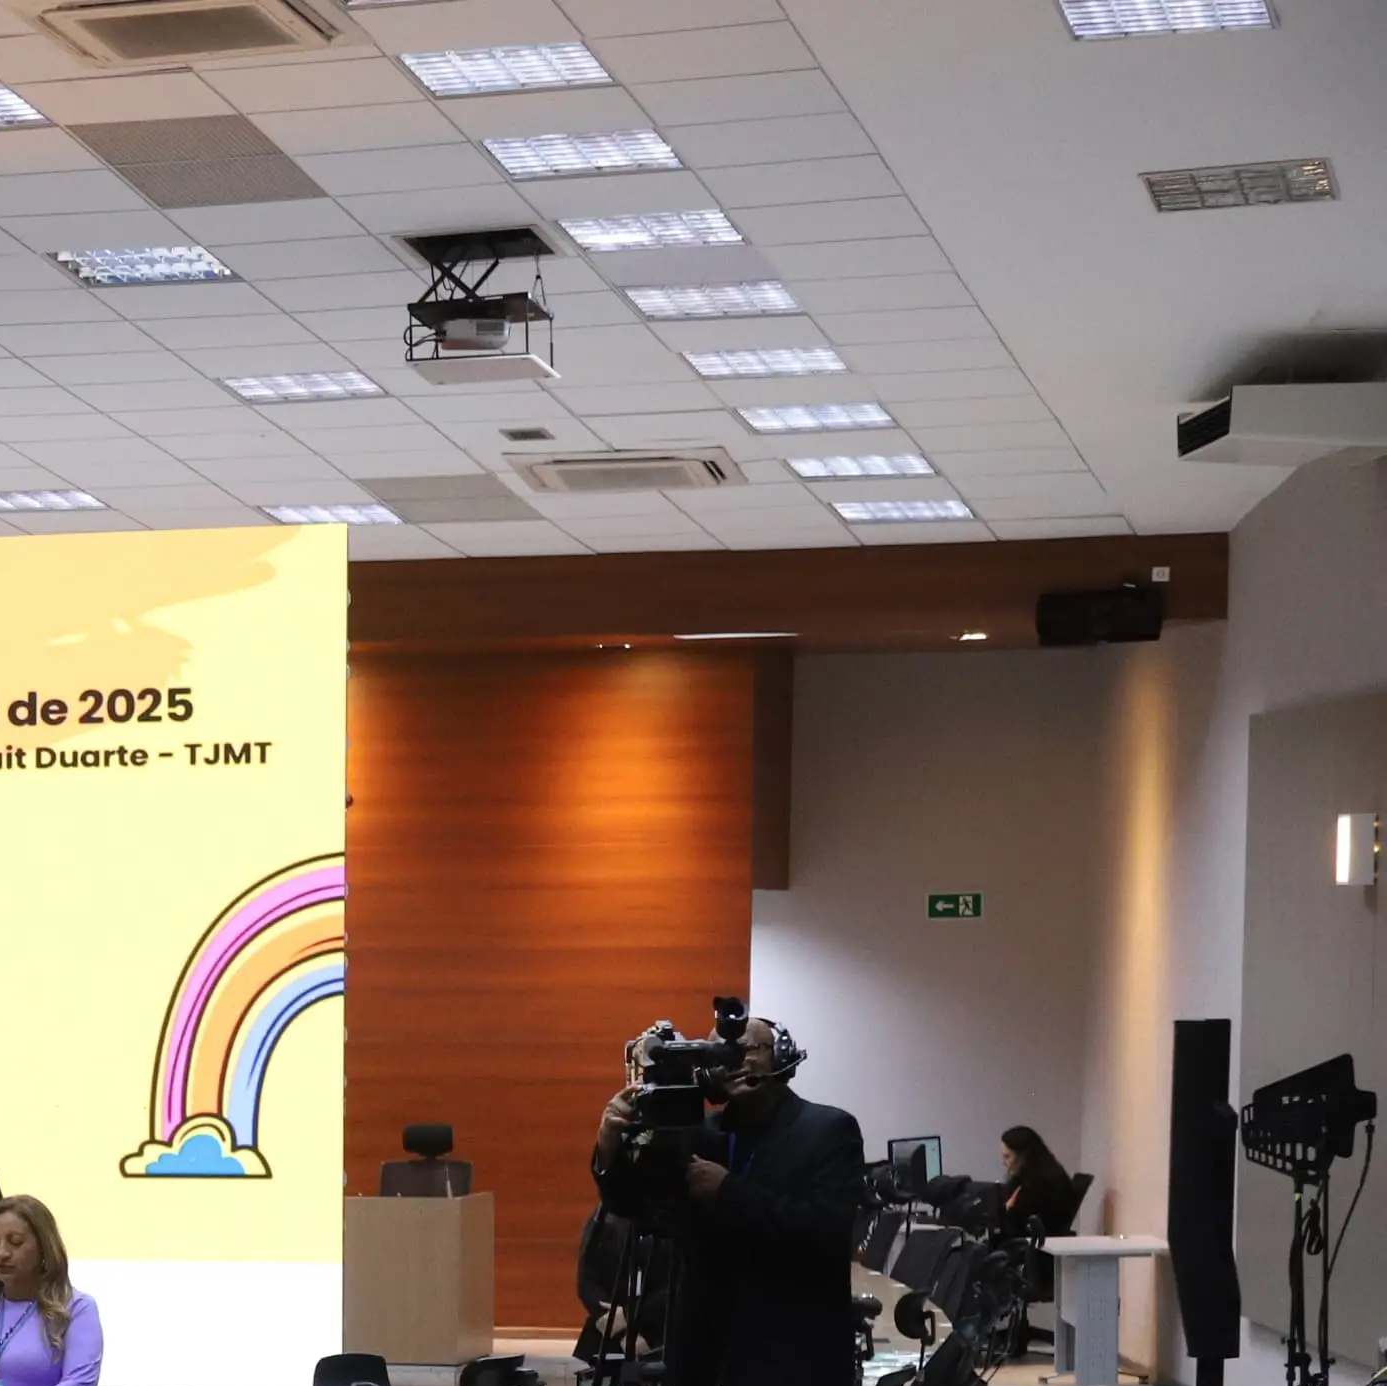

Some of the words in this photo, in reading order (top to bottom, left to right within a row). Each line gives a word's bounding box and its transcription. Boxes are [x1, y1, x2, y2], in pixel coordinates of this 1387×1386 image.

[6, 690, 69, 728] de
[77, 687, 194, 725] 2025
[35, 744, 149, 770] Duarte
[183, 741, 273, 767] TJMT
